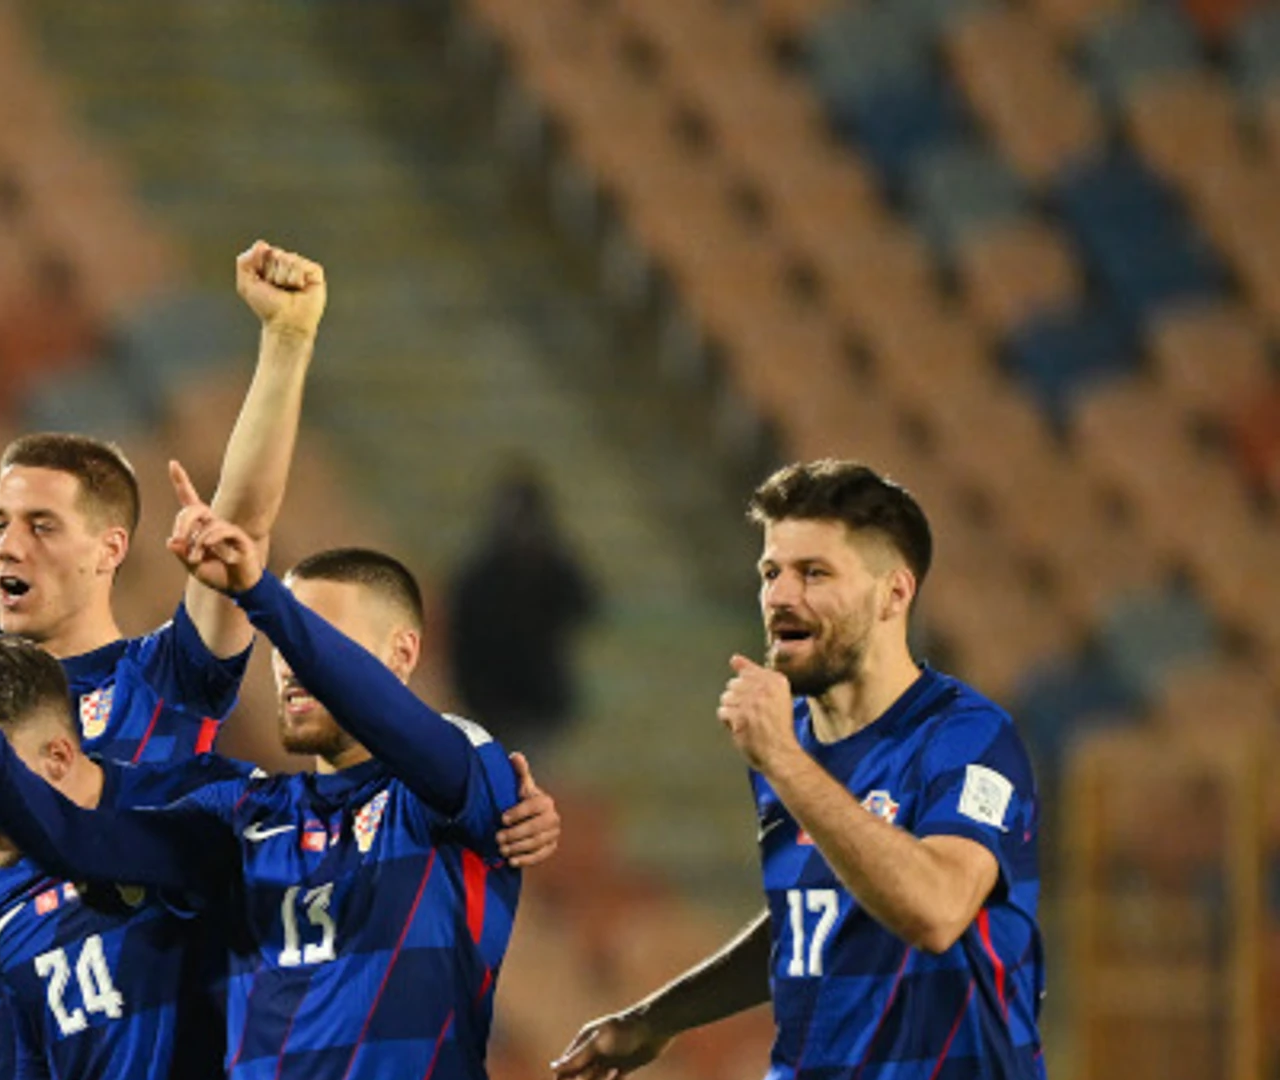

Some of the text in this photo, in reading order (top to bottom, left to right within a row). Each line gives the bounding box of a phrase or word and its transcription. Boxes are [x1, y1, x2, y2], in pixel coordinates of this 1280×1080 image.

[277, 882, 337, 967] 13
[786, 889, 839, 977] 17
[34, 934, 124, 1036] 24
